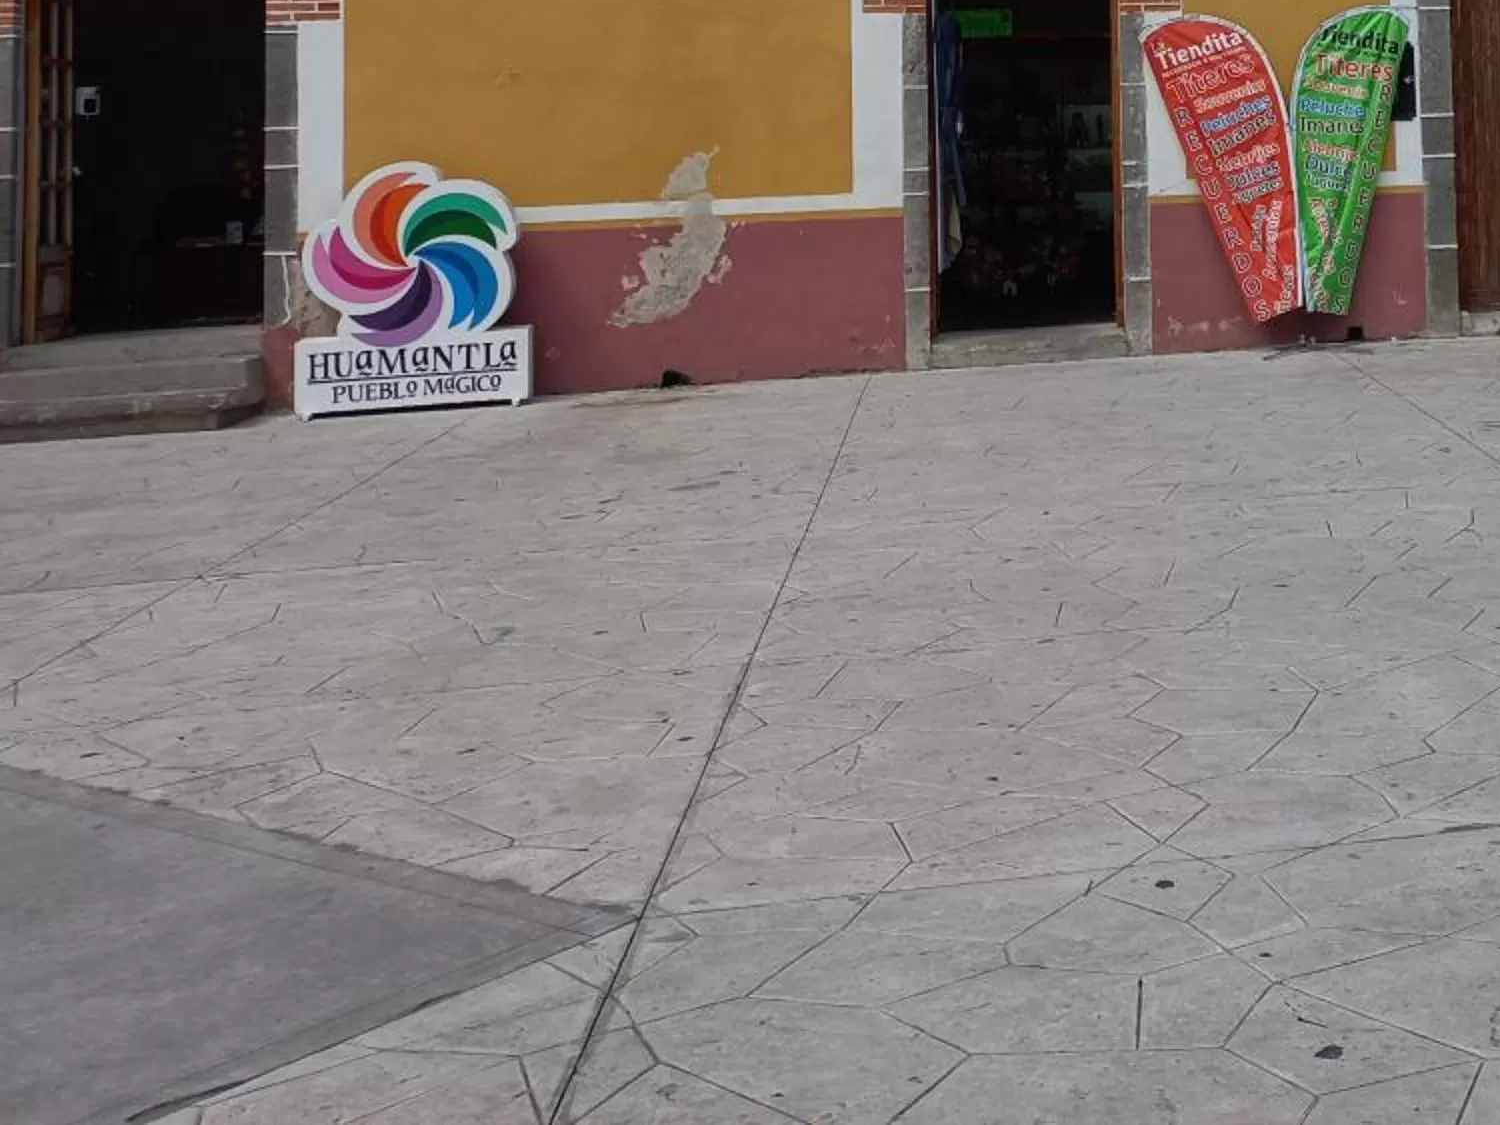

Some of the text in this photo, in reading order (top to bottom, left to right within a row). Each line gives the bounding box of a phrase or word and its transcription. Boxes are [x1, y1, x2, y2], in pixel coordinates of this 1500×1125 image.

[1155, 32, 1244, 70] Tiendita
[1321, 24, 1399, 55] Tiendita
[1207, 109, 1276, 157] Imanes
